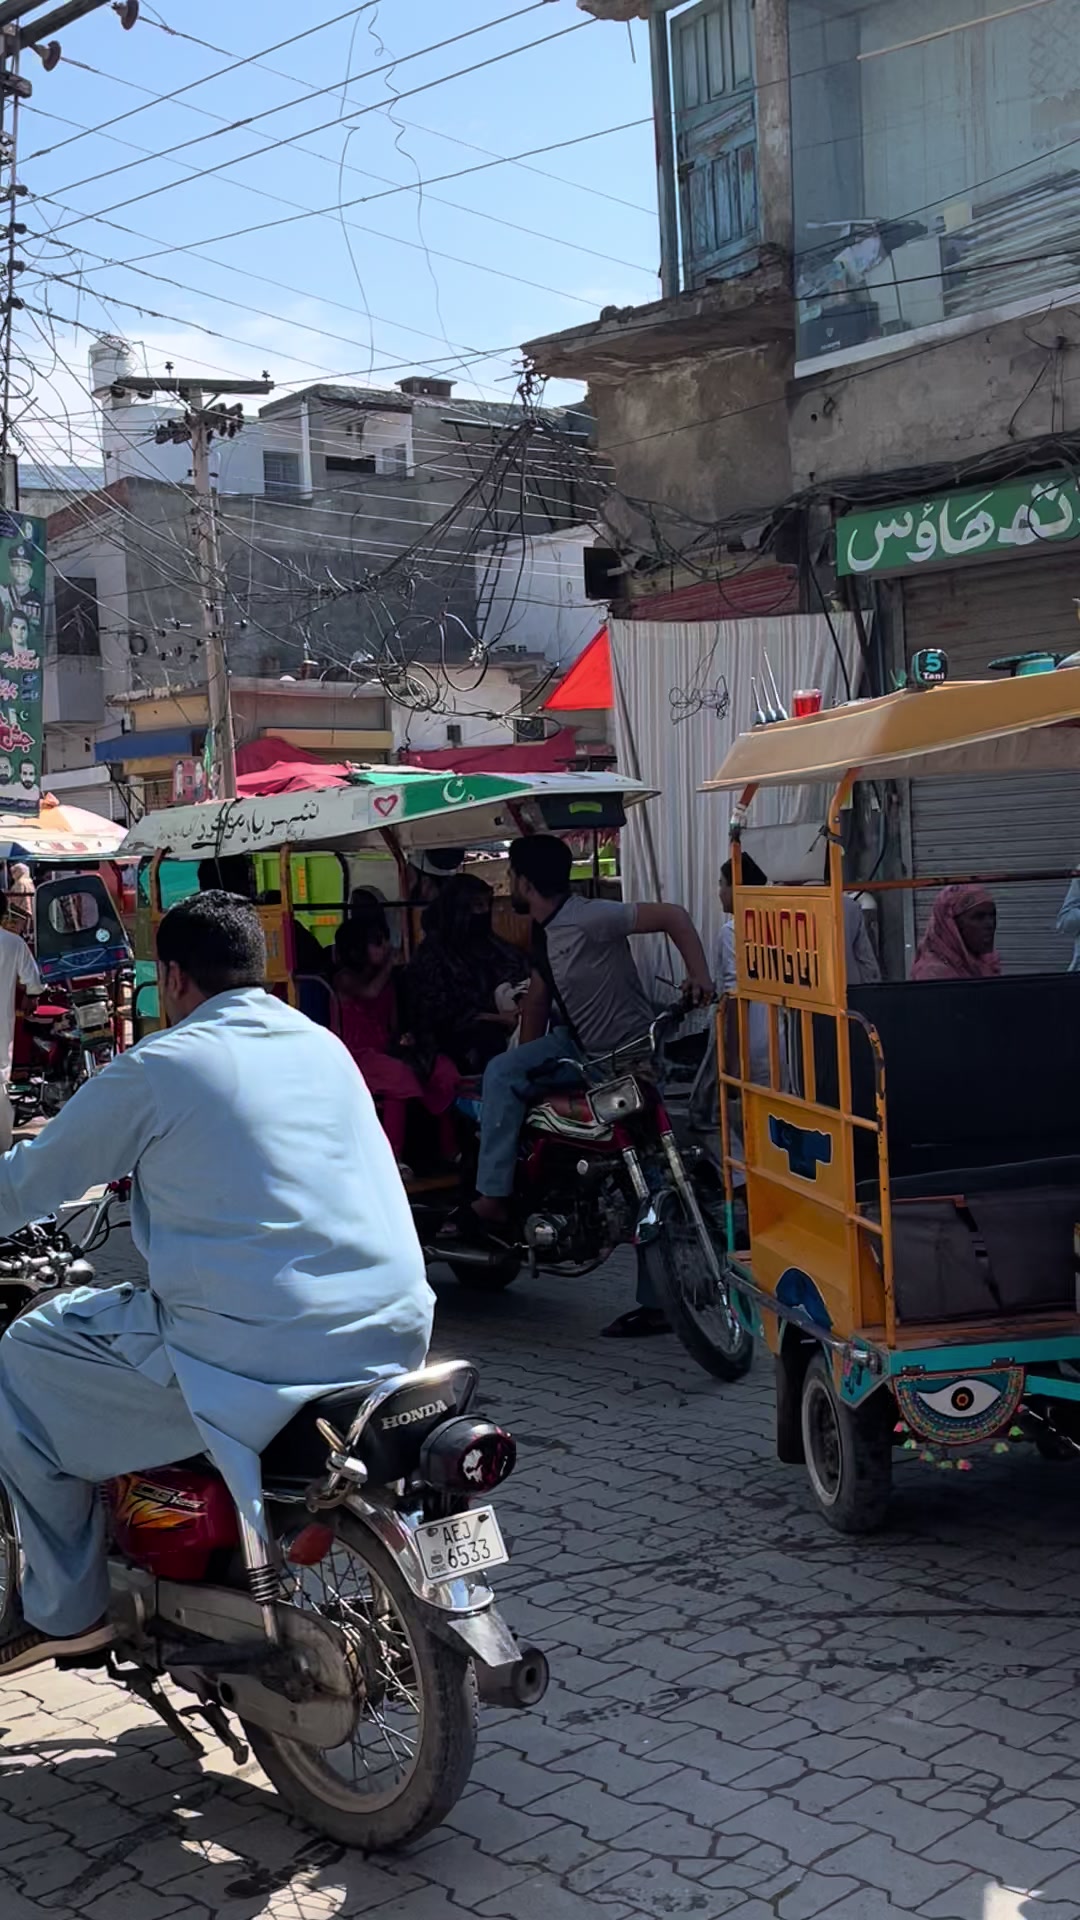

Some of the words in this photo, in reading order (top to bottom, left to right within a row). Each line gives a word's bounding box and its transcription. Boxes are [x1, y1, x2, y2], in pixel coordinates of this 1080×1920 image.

[926, 653, 942, 672] 5
[744, 908, 819, 990] QINGQI
[381, 1400, 448, 1430] HONDA
[443, 1521, 471, 1545] AEJ
[448, 1539, 491, 1568] 6533
